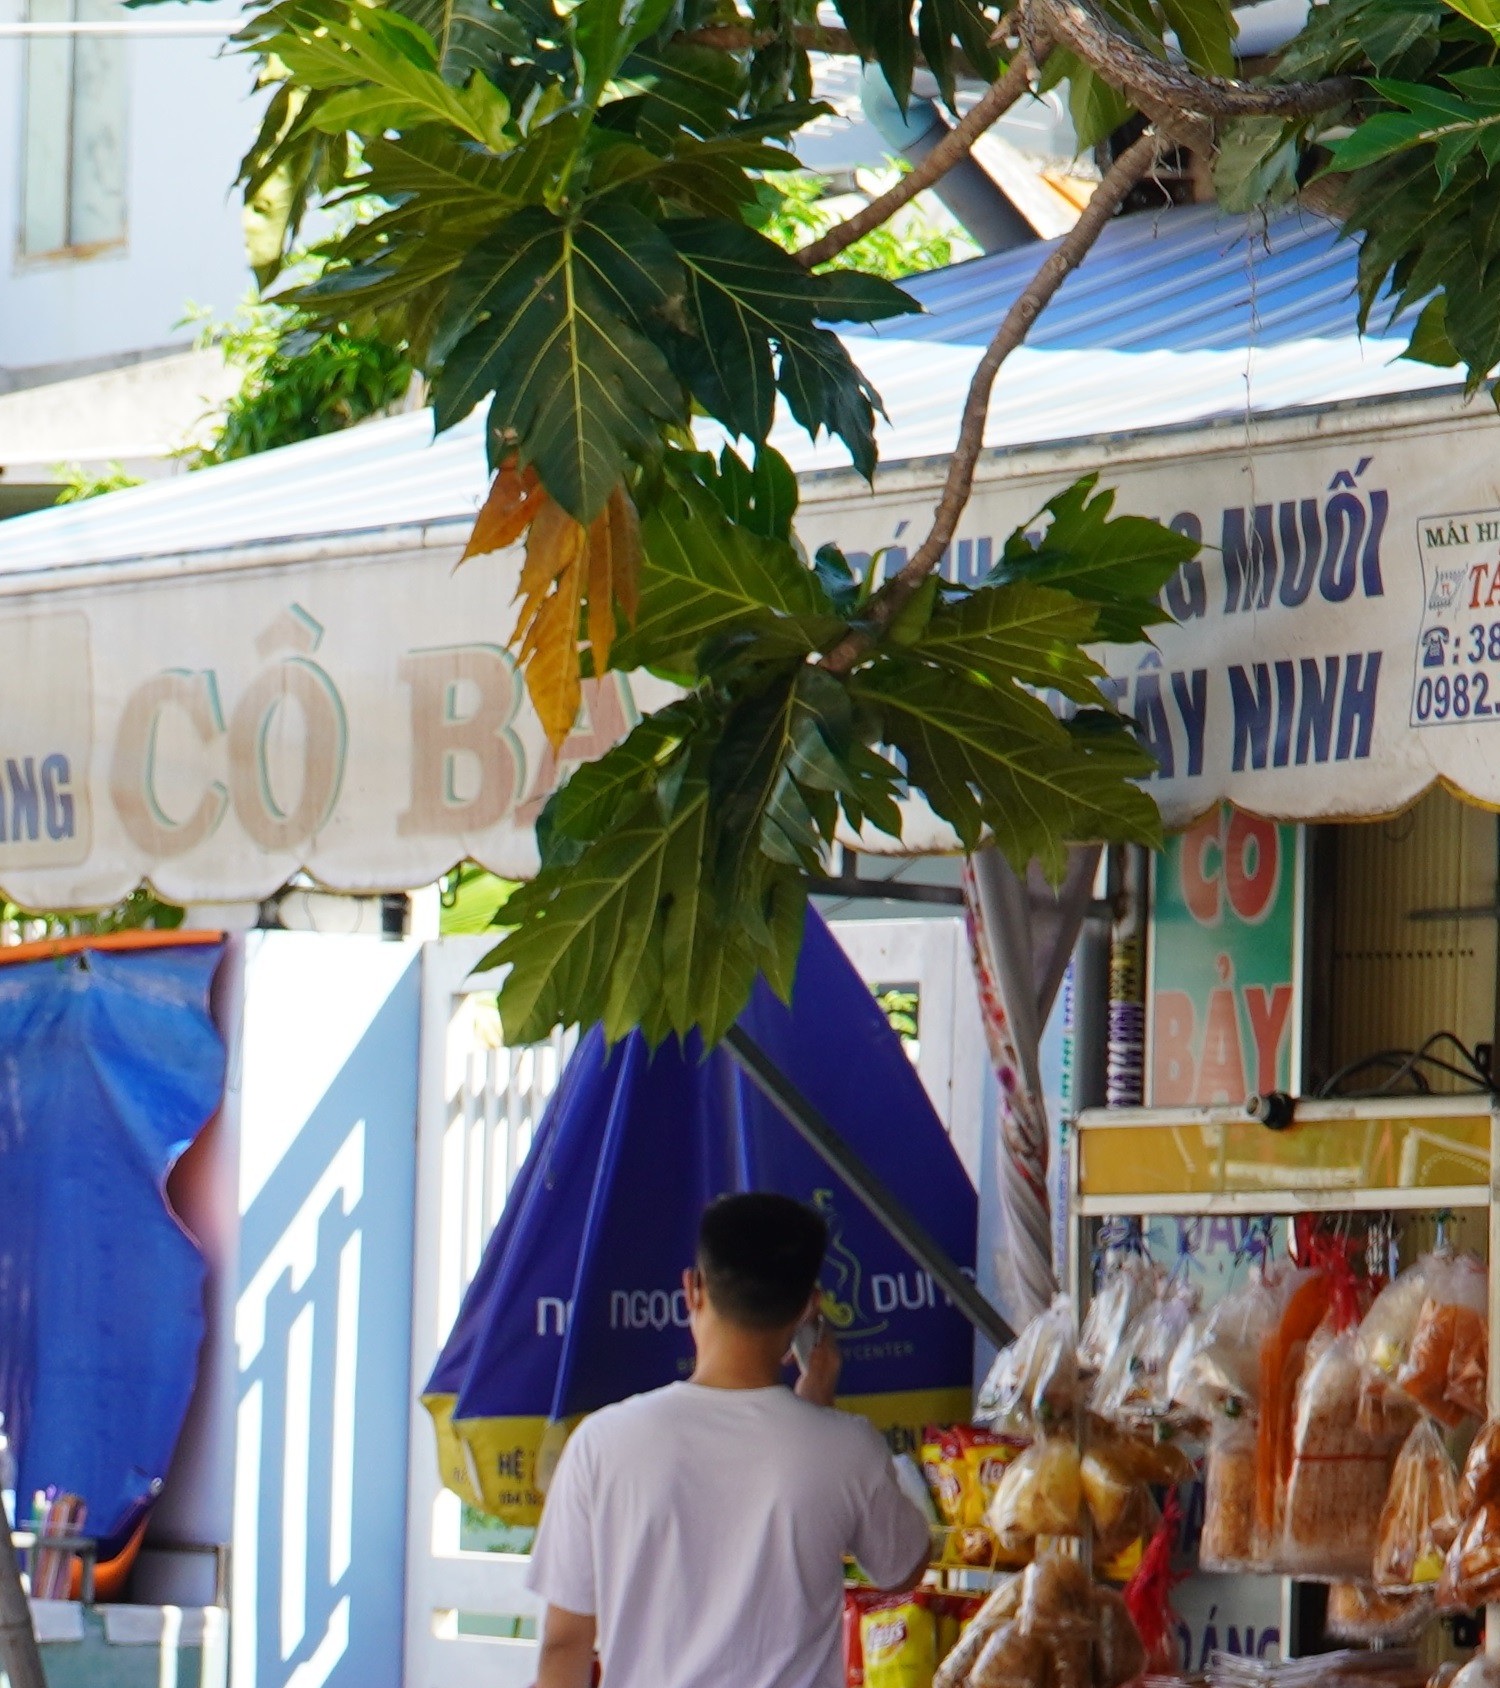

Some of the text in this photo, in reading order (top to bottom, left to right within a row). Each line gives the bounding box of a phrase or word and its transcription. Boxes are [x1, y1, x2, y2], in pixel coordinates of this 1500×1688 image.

[1222, 457, 1388, 615] MUỐI
[1425, 518, 1469, 548] MÁI
[108, 603, 351, 858] CÔ
[1228, 650, 1382, 773] NINH
[871, 1269, 977, 1314] DU
